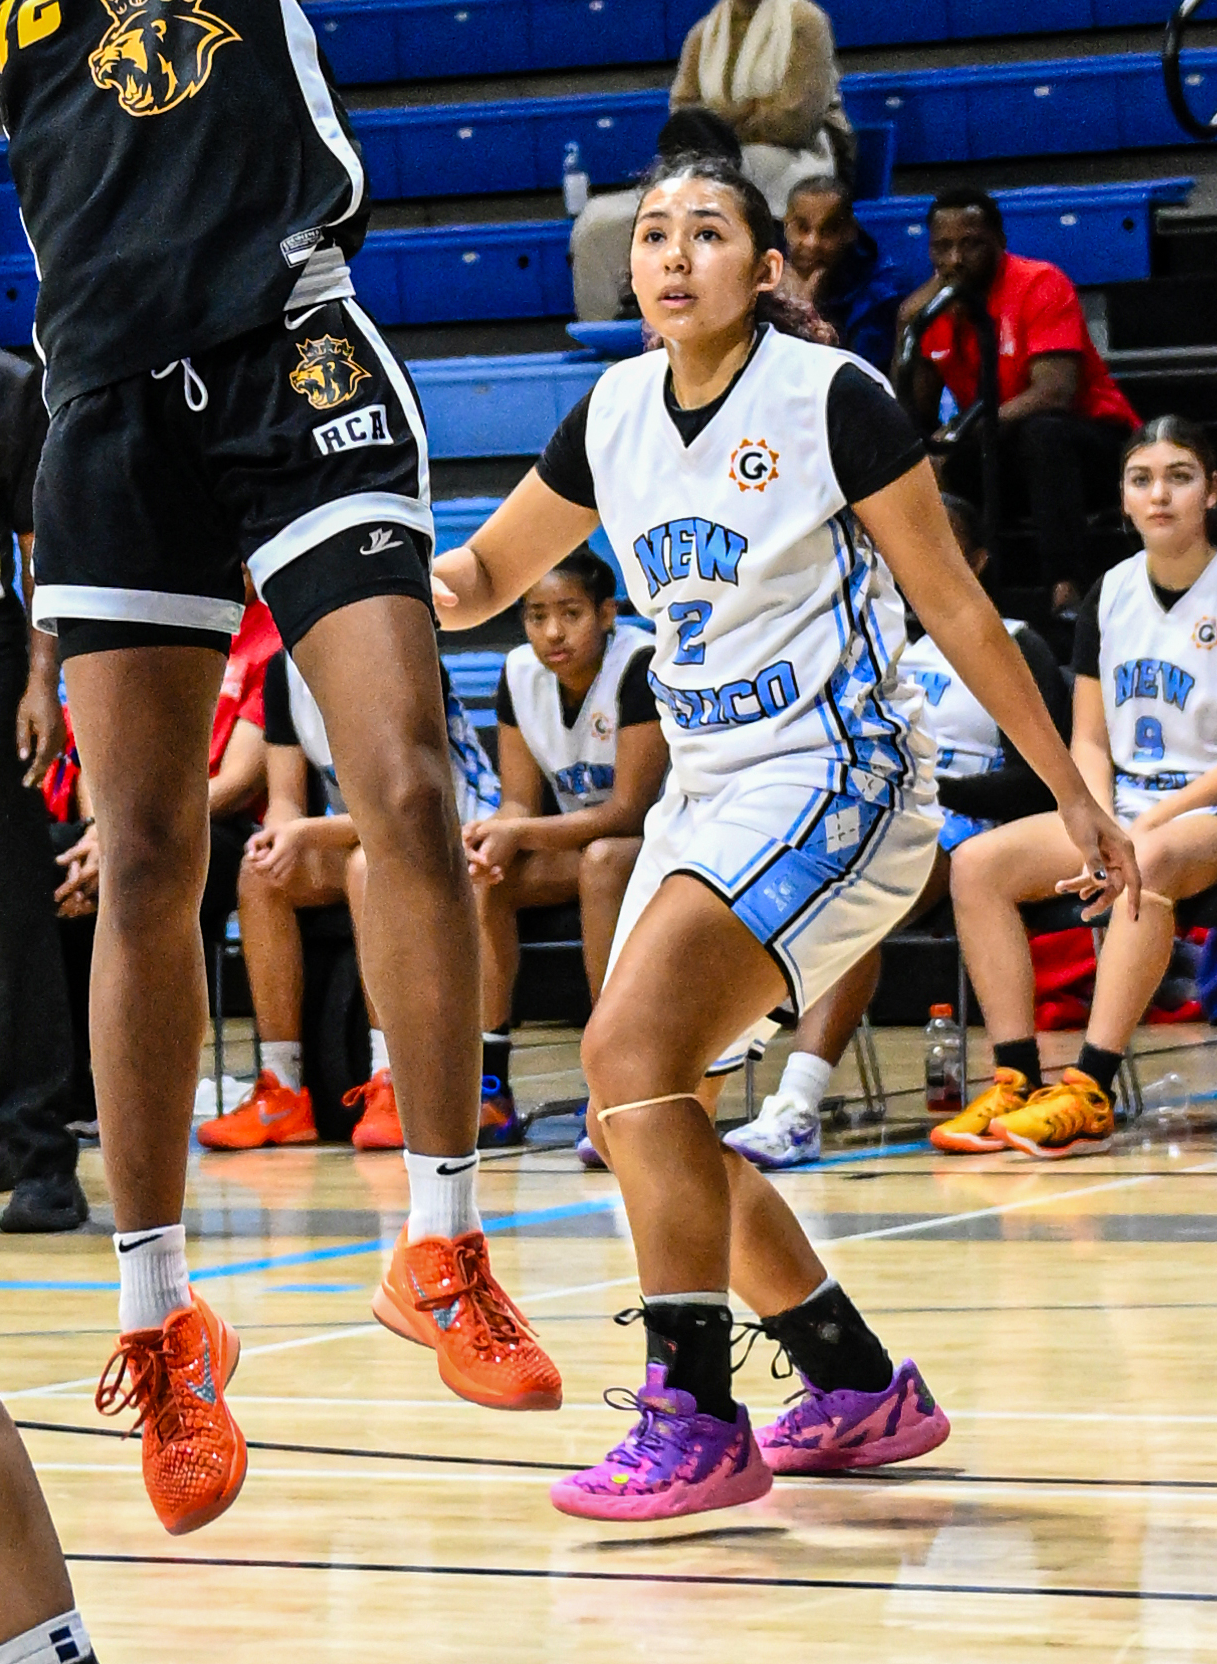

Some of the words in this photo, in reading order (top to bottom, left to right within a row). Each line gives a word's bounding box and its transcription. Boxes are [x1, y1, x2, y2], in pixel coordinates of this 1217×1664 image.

[321, 410, 386, 453] RCA
[632, 516, 749, 600] NEW
[668, 598, 713, 666] 2
[1113, 657, 1195, 712] NEW
[1133, 715, 1165, 762] 9
